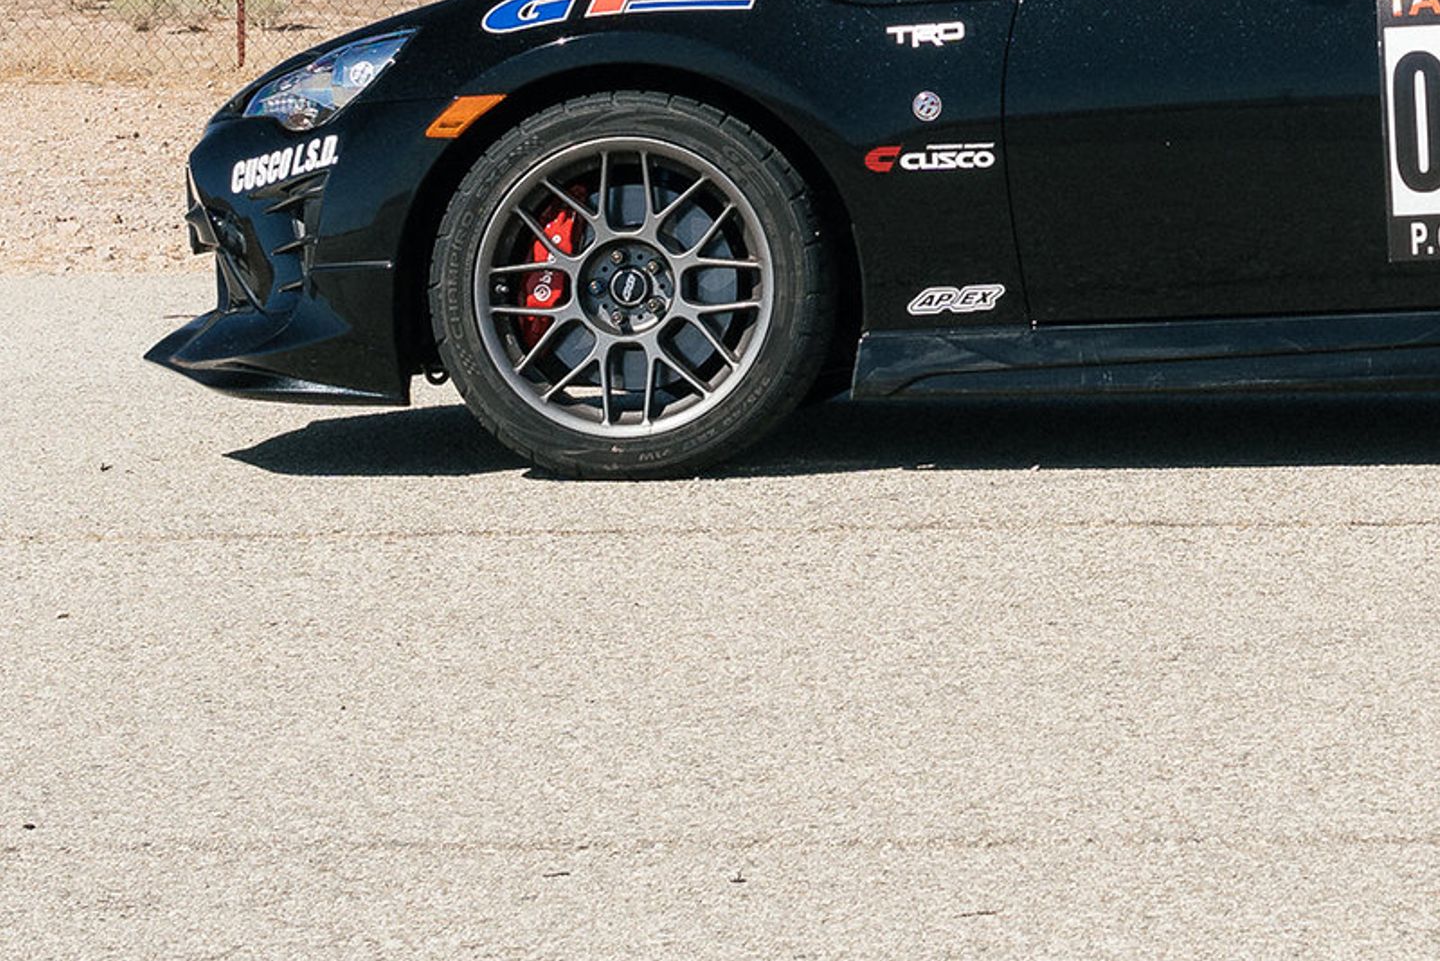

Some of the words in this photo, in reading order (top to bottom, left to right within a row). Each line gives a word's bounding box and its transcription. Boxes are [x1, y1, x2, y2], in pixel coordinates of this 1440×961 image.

[885, 21, 966, 48] TRD
[231, 147, 294, 194] CUSCO
[900, 150, 995, 171] CUSCO
[1410, 222, 1434, 255] P.
